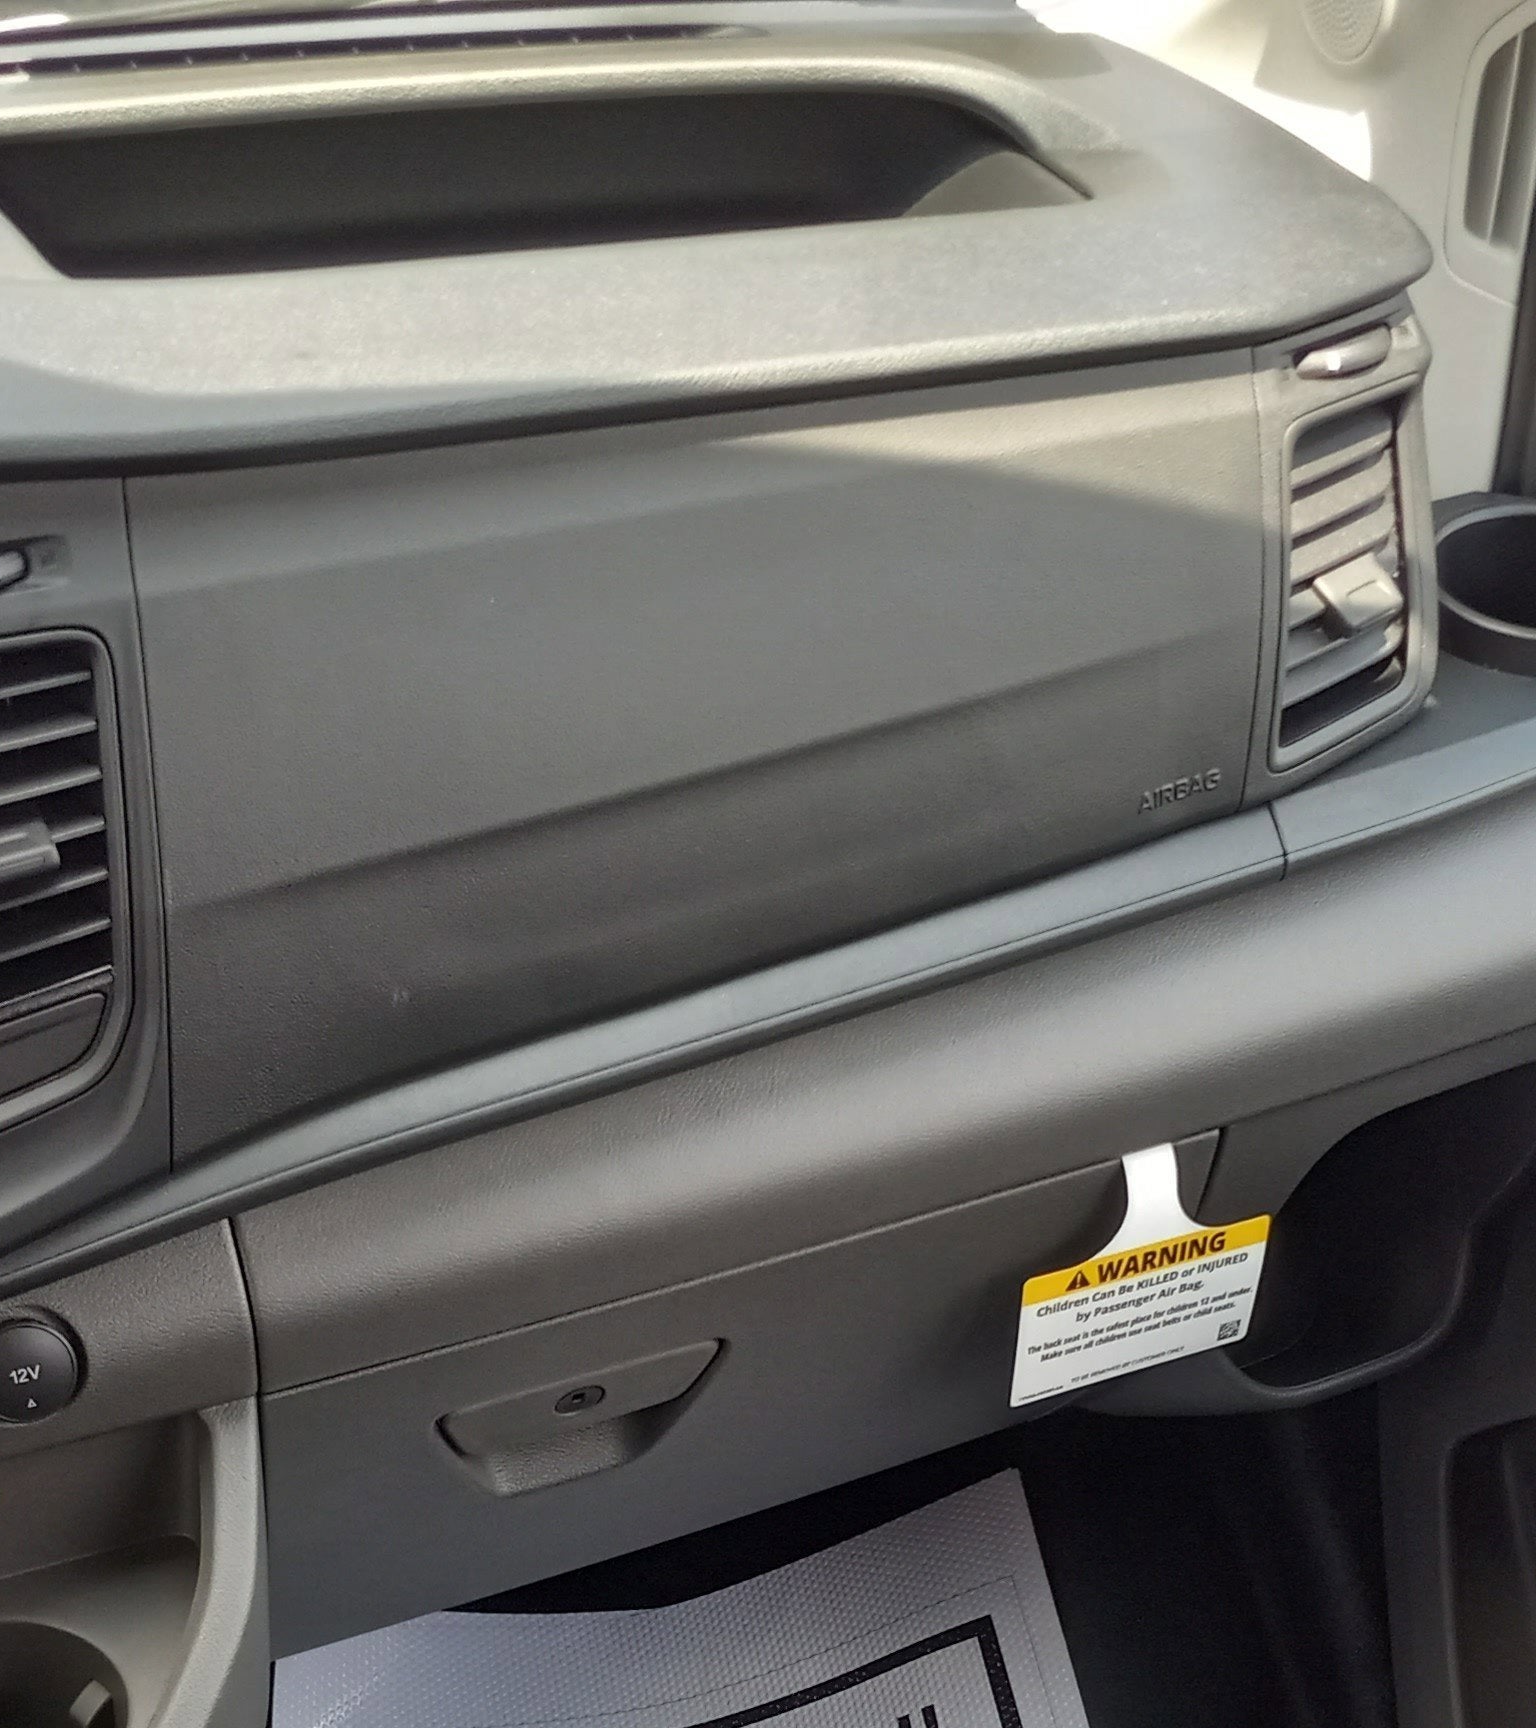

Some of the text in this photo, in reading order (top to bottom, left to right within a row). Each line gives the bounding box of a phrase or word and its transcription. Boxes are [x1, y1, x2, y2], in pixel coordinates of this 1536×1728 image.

[1137, 767, 1222, 815] AIRBAG
[1097, 1231, 1226, 1285] WARNING
[1036, 1252, 1249, 1318] Children Can Be KILLED or INJURED
[1076, 1311, 1092, 1323] by
[1093, 1292, 1156, 1318] Passenger
[1157, 1287, 1177, 1300] Air
[1027, 1344, 1042, 1355] The
[1063, 1333, 1081, 1345] seat
[1082, 1331, 1089, 1339] is
[1090, 1326, 1104, 1337] the
[1153, 1308, 1166, 1319] for
[1040, 1350, 1063, 1363] Make
[1095, 1332, 1127, 1347] children
[1128, 1327, 1143, 1337] use
[1144, 1321, 1161, 1333] seat
[9, 1363, 41, 1385] 12V
